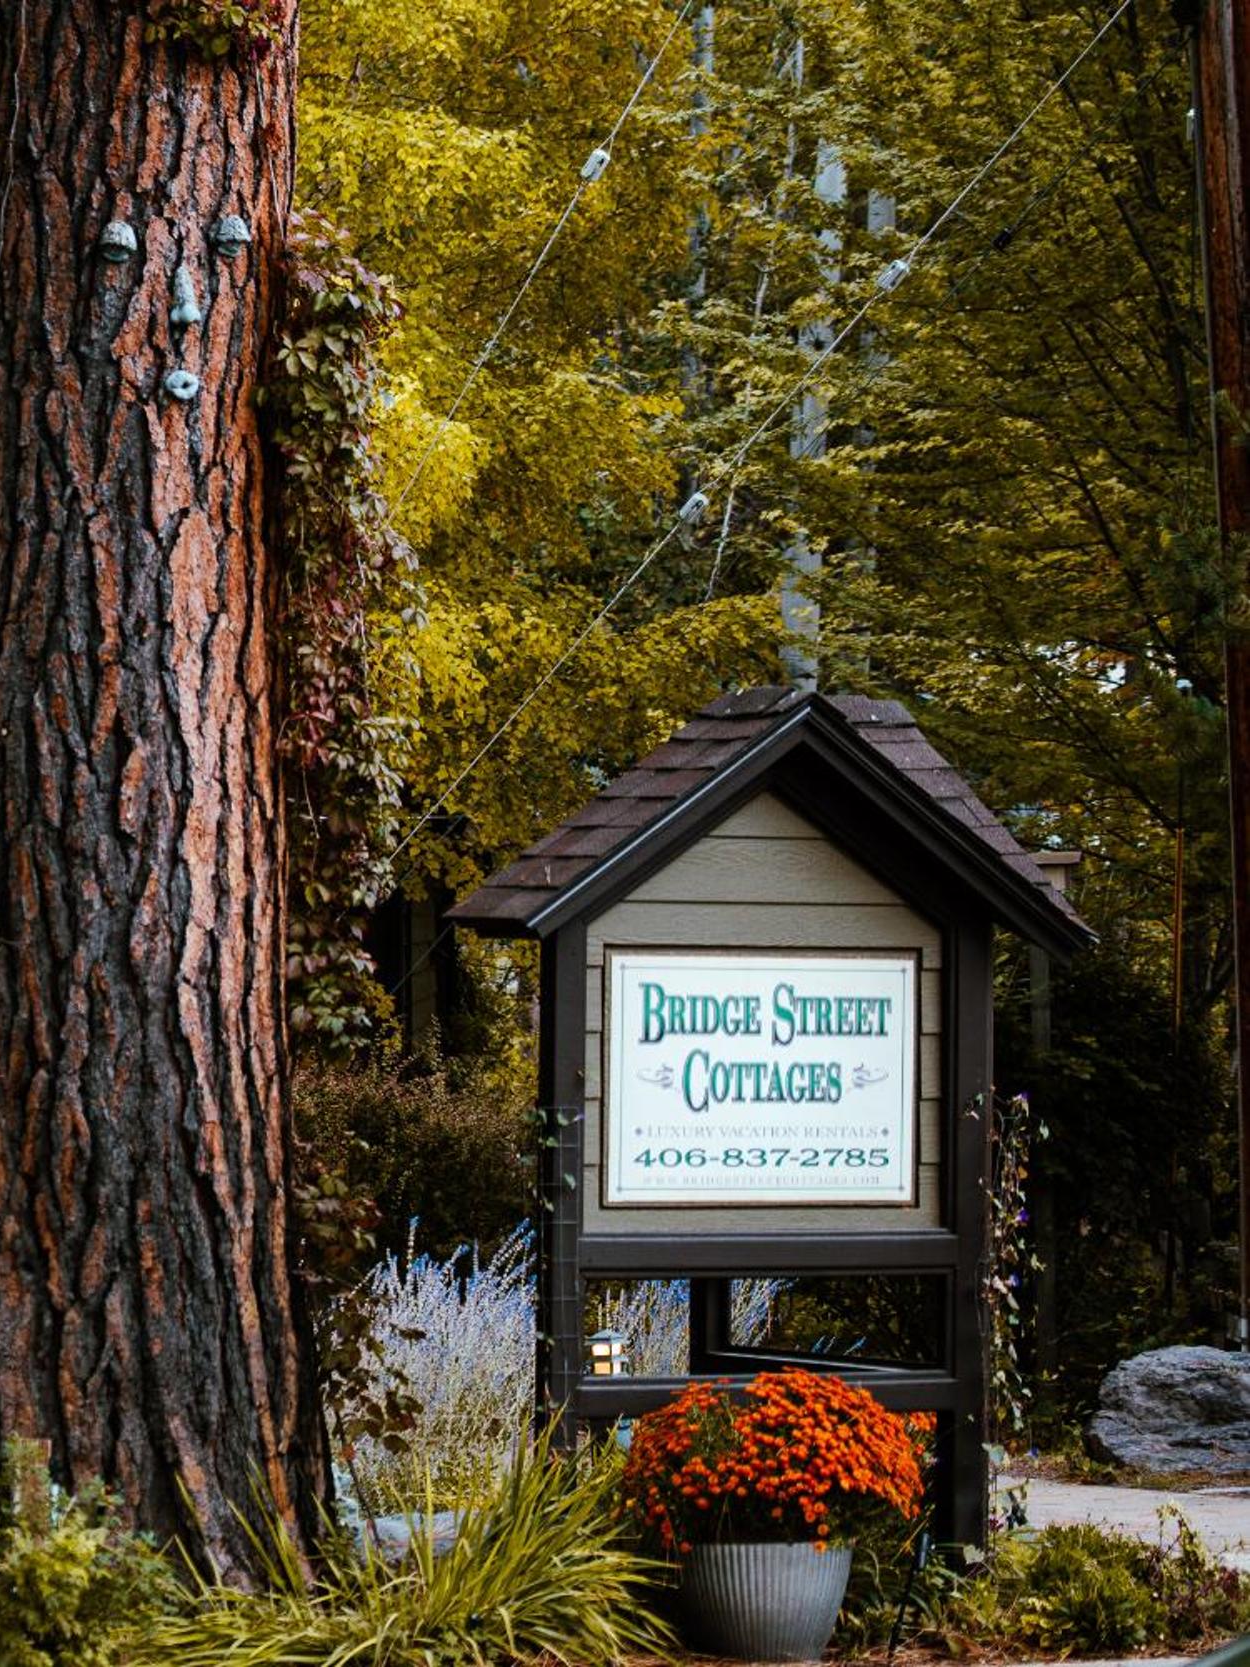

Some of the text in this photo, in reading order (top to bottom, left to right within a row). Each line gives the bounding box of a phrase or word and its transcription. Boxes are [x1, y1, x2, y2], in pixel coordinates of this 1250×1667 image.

[639, 982, 892, 1046] BRIDGE STREET
[682, 1048, 842, 1112] COTTAGES
[646, 1126, 878, 1138] LUXURY VACATION RENTALS
[634, 1148, 890, 1168] 406-837-2785
